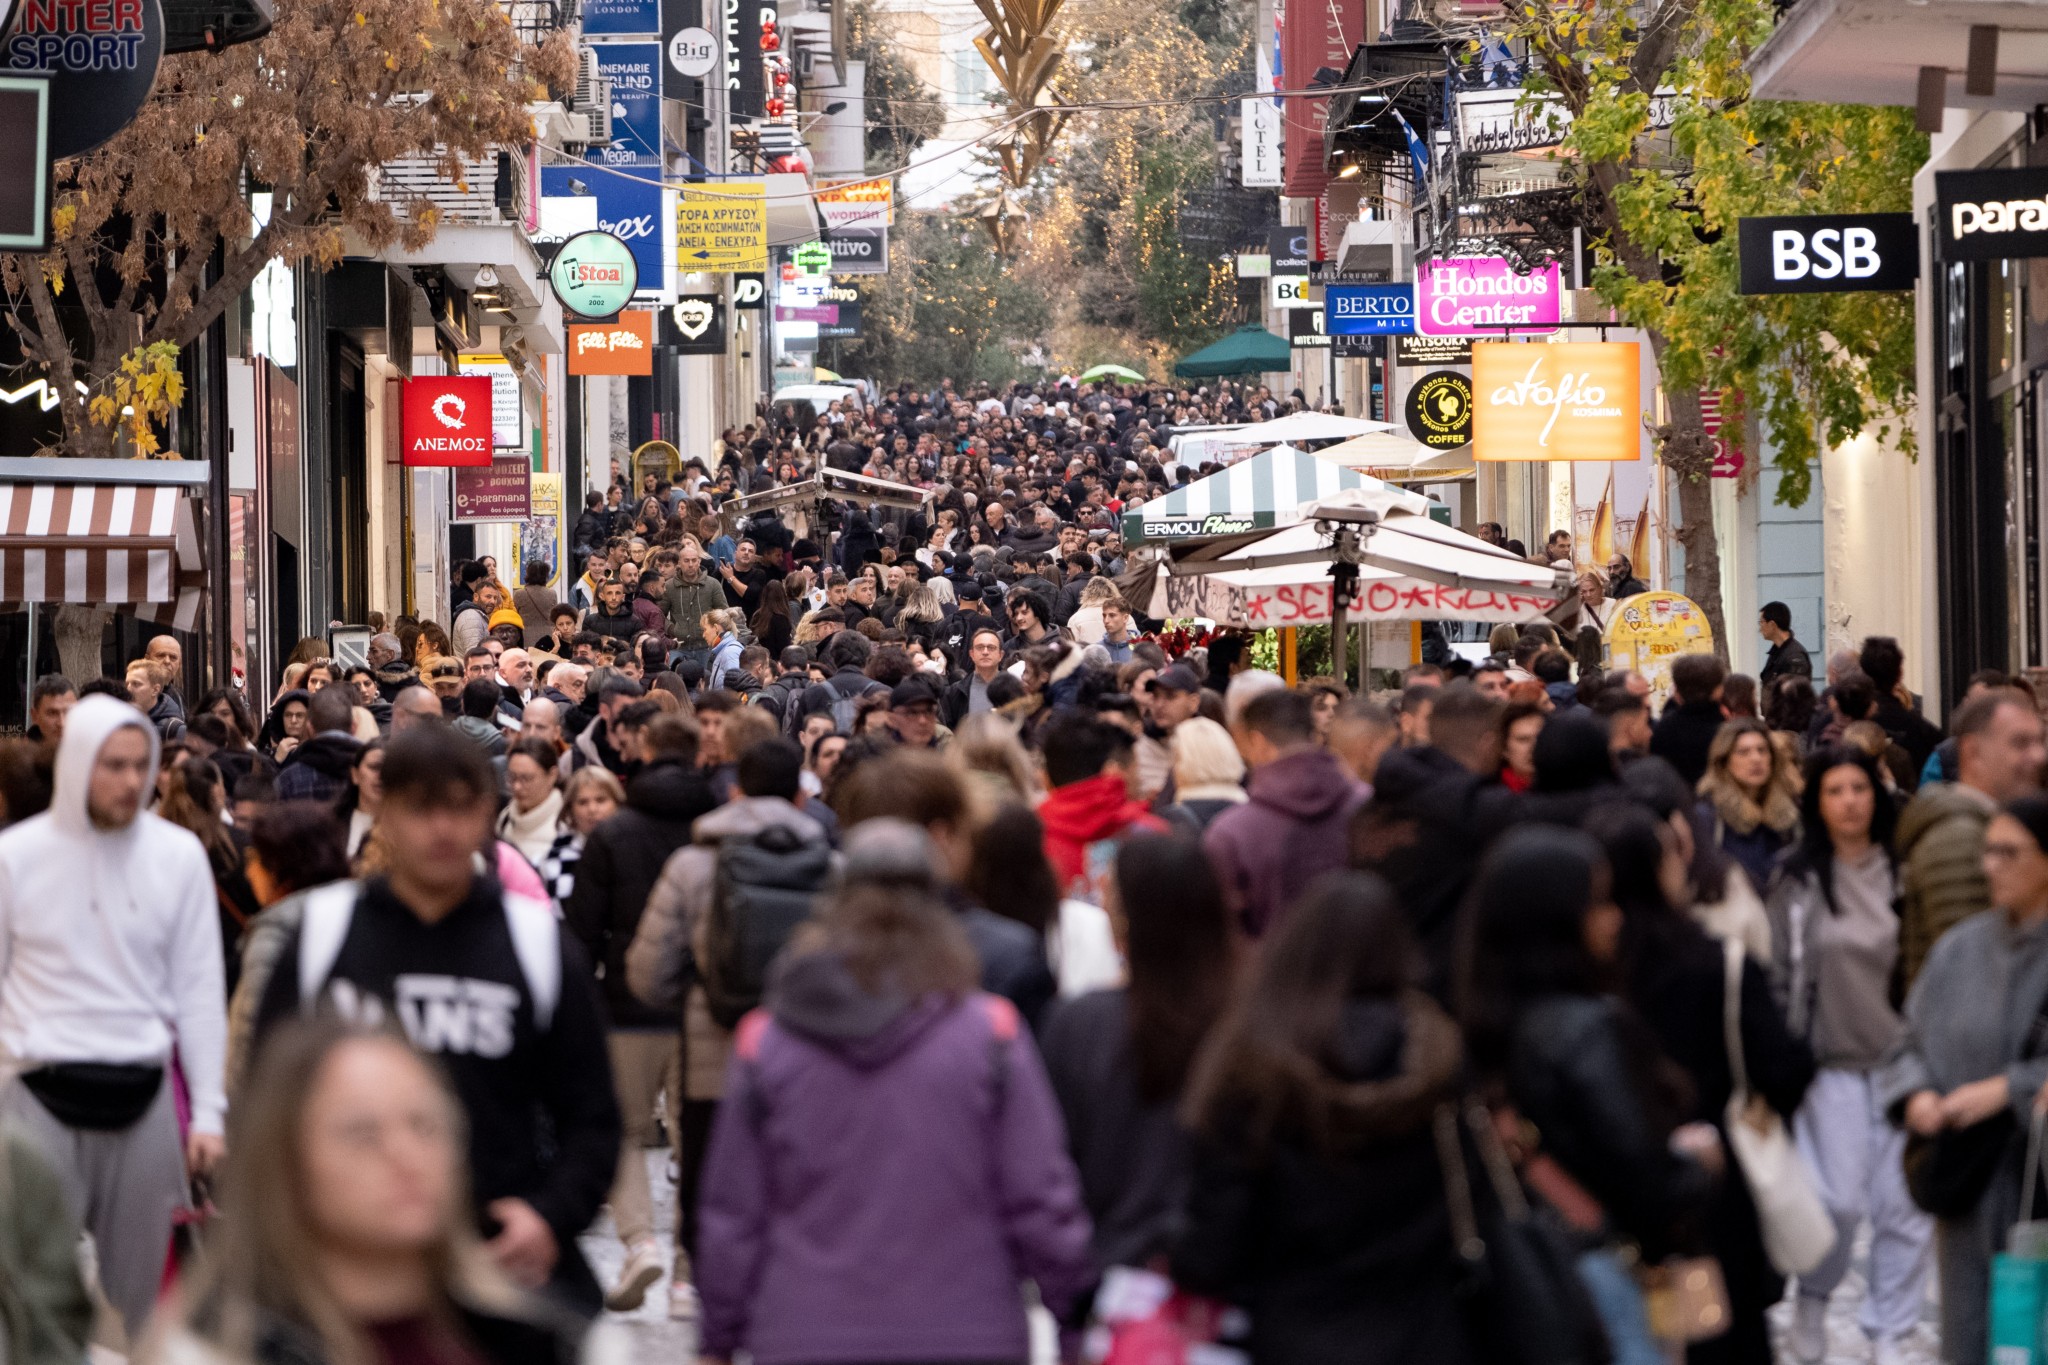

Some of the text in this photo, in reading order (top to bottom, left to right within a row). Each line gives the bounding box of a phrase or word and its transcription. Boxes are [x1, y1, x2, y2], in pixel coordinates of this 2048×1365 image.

[595, 6, 640, 14] LONDON
[9, 33, 145, 71] SPORT
[677, 43, 709, 58] Big
[713, 209, 757, 220] ΧΡΥΣΟΥ
[826, 211, 880, 221] woman
[1953, 195, 2048, 241] para
[715, 236, 758, 246] ΕΝΕΧΥΡΑ
[1773, 228, 1881, 281] BSB
[571, 265, 620, 281] iStoa
[1431, 266, 1548, 296] Hondos
[1336, 297, 1410, 314] BERTO
[1431, 296, 1537, 327] Center
[1377, 319, 1408, 327] MIL
[578, 331, 644, 355] Folli Follie
[1403, 337, 1468, 348] MATSOUKA
[488, 371, 514, 379] Athens
[1418, 377, 1471, 401] mykonos charm
[1572, 408, 1622, 417] KOSMIMA
[1420, 412, 1471, 433] mykonos charm
[1427, 434, 1465, 444] COFFEE
[457, 494, 526, 507] e-paramana
[1143, 516, 1252, 535] ERMOU Flower
